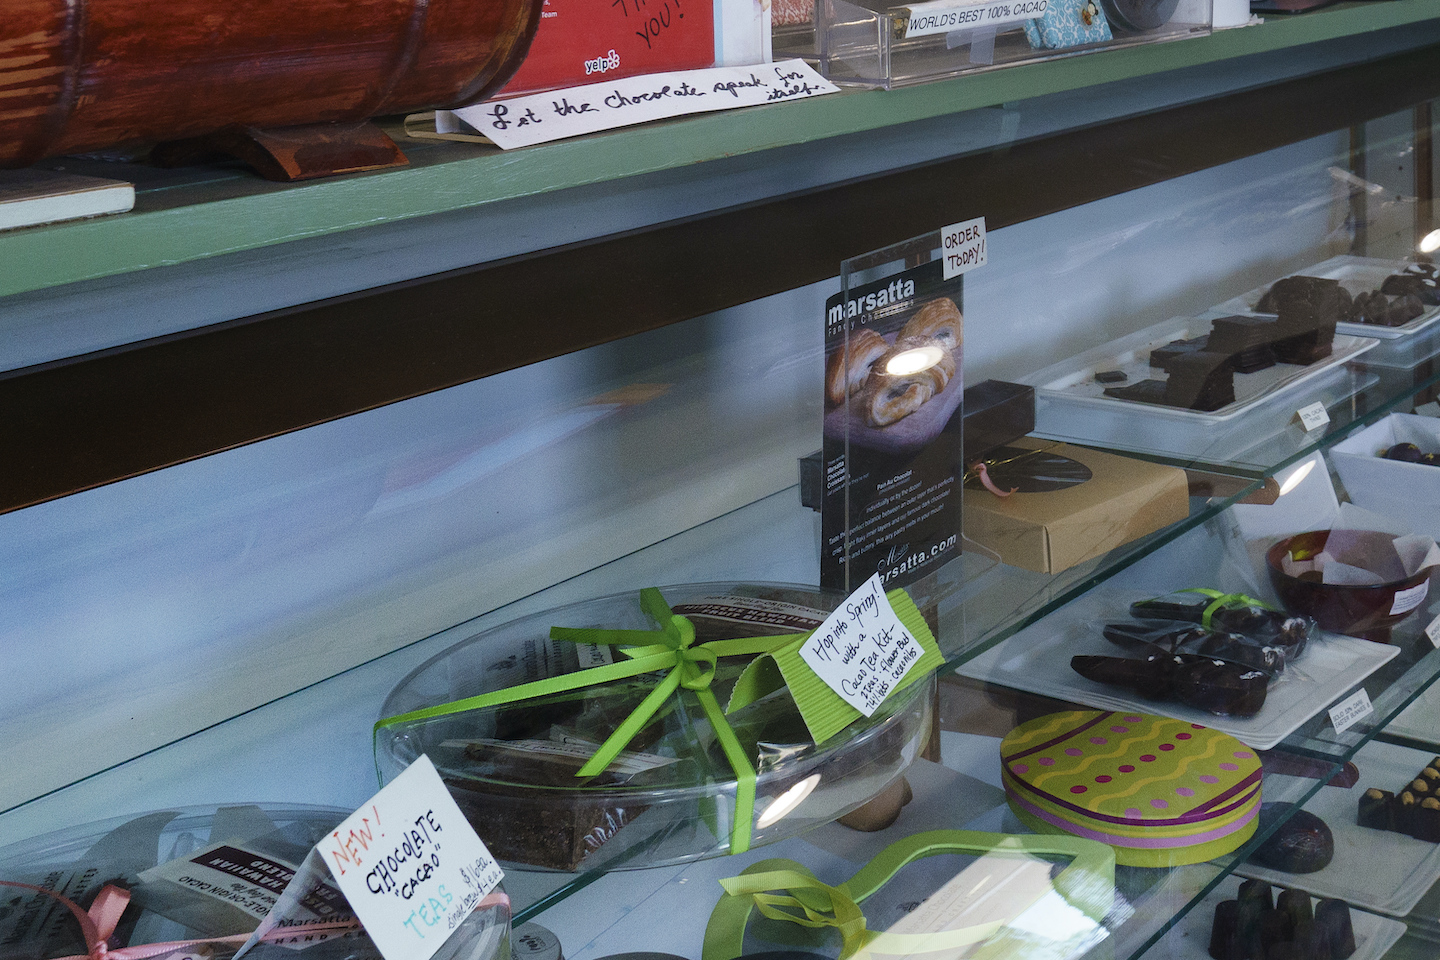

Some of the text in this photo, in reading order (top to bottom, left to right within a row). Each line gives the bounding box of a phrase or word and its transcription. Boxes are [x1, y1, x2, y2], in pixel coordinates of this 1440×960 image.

[910, 0, 1047, 31] WORLD'S BEST 100% CACAO
[585, 57, 609, 75] yelp
[488, 104, 542, 129] Let
[554, 97, 600, 116] the
[713, 73, 767, 93] speak
[775, 67, 804, 87] for
[944, 224, 981, 249] ORDER
[948, 239, 985, 271] TODAY!
[828, 278, 915, 326] marsatta
[880, 534, 956, 584] arsatta.com
[812, 581, 880, 661] Hop into Spring!
[842, 633, 866, 665] with a
[841, 652, 879, 696] Cacao Tea
[331, 805, 386, 875] NEW!
[366, 809, 443, 894] CHOCOLATE
[403, 884, 453, 939] TEAS
